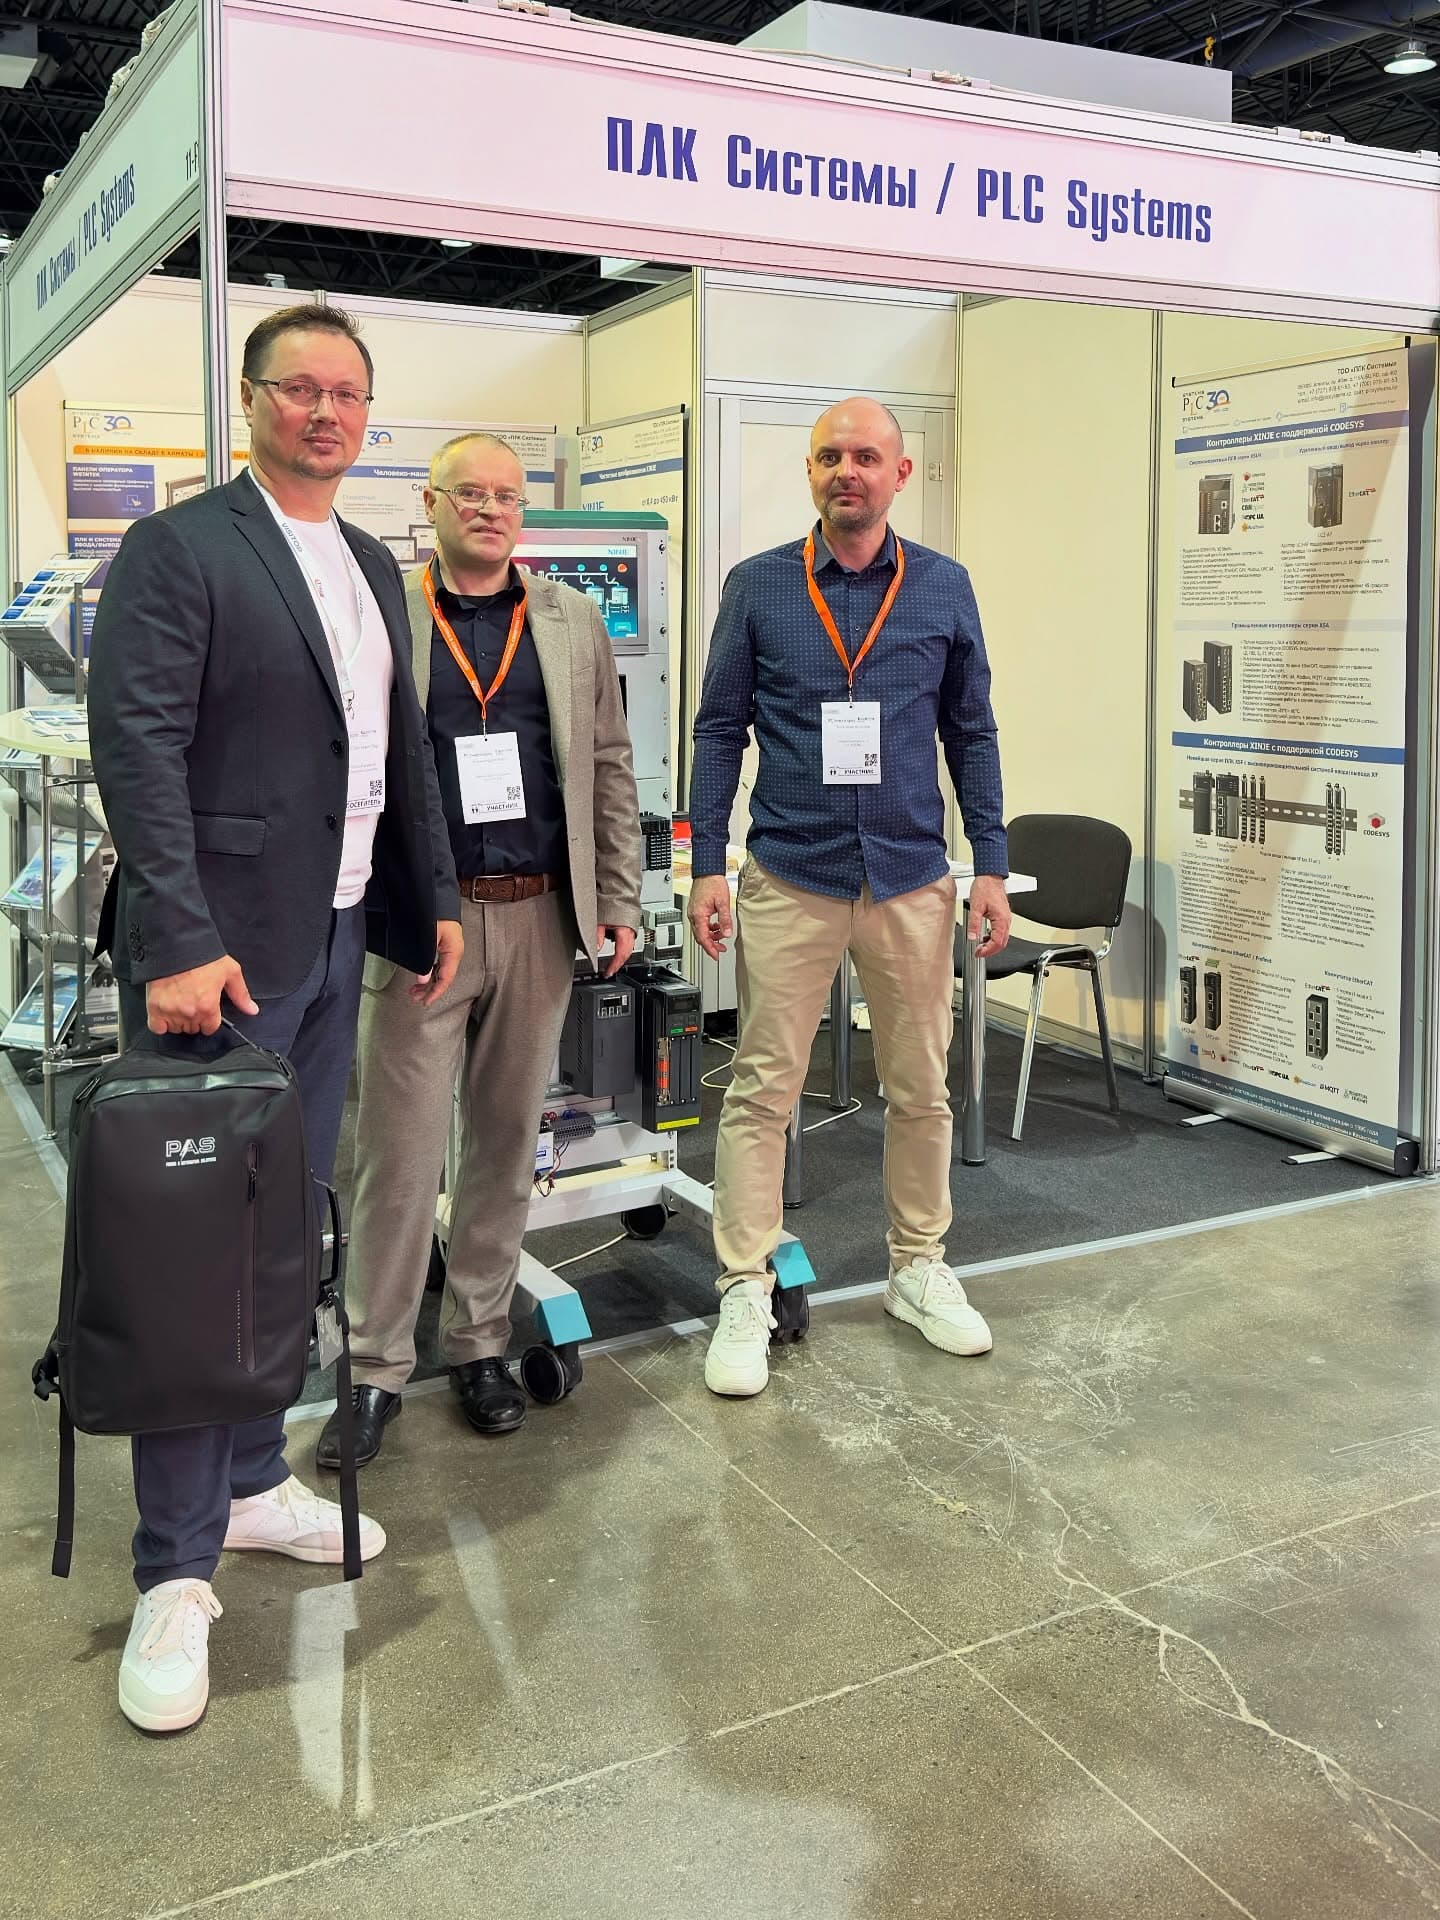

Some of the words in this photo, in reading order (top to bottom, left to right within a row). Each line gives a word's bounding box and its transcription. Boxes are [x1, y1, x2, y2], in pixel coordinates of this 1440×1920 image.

[607, 116, 698, 182] ПЛК
[727, 134, 916, 209] Системы
[936, 163, 955, 214] /
[977, 168, 1044, 223] PLC
[1067, 180, 1211, 243] Systems
[50, 236, 76, 297] Системы
[83, 201, 97, 256] PLC
[100, 163, 135, 243] Systems
[1206, 390, 1230, 410] 30
[1206, 436, 1252, 448] Контроллеры
[1254, 432, 1274, 440] XINJE
[1282, 424, 1328, 438] поддержкой
[1330, 420, 1364, 432] CODESYS
[1204, 738, 1248, 749] Контроллеры
[1250, 742, 1270, 750] XINJE
[1276, 745, 1324, 756] поддержкой
[1326, 748, 1359, 758] CODESYS
[1363, 830, 1390, 838] CODESYS
[1324, 1084, 1340, 1094] MQTT
[166, 1136, 216, 1159] PAS
